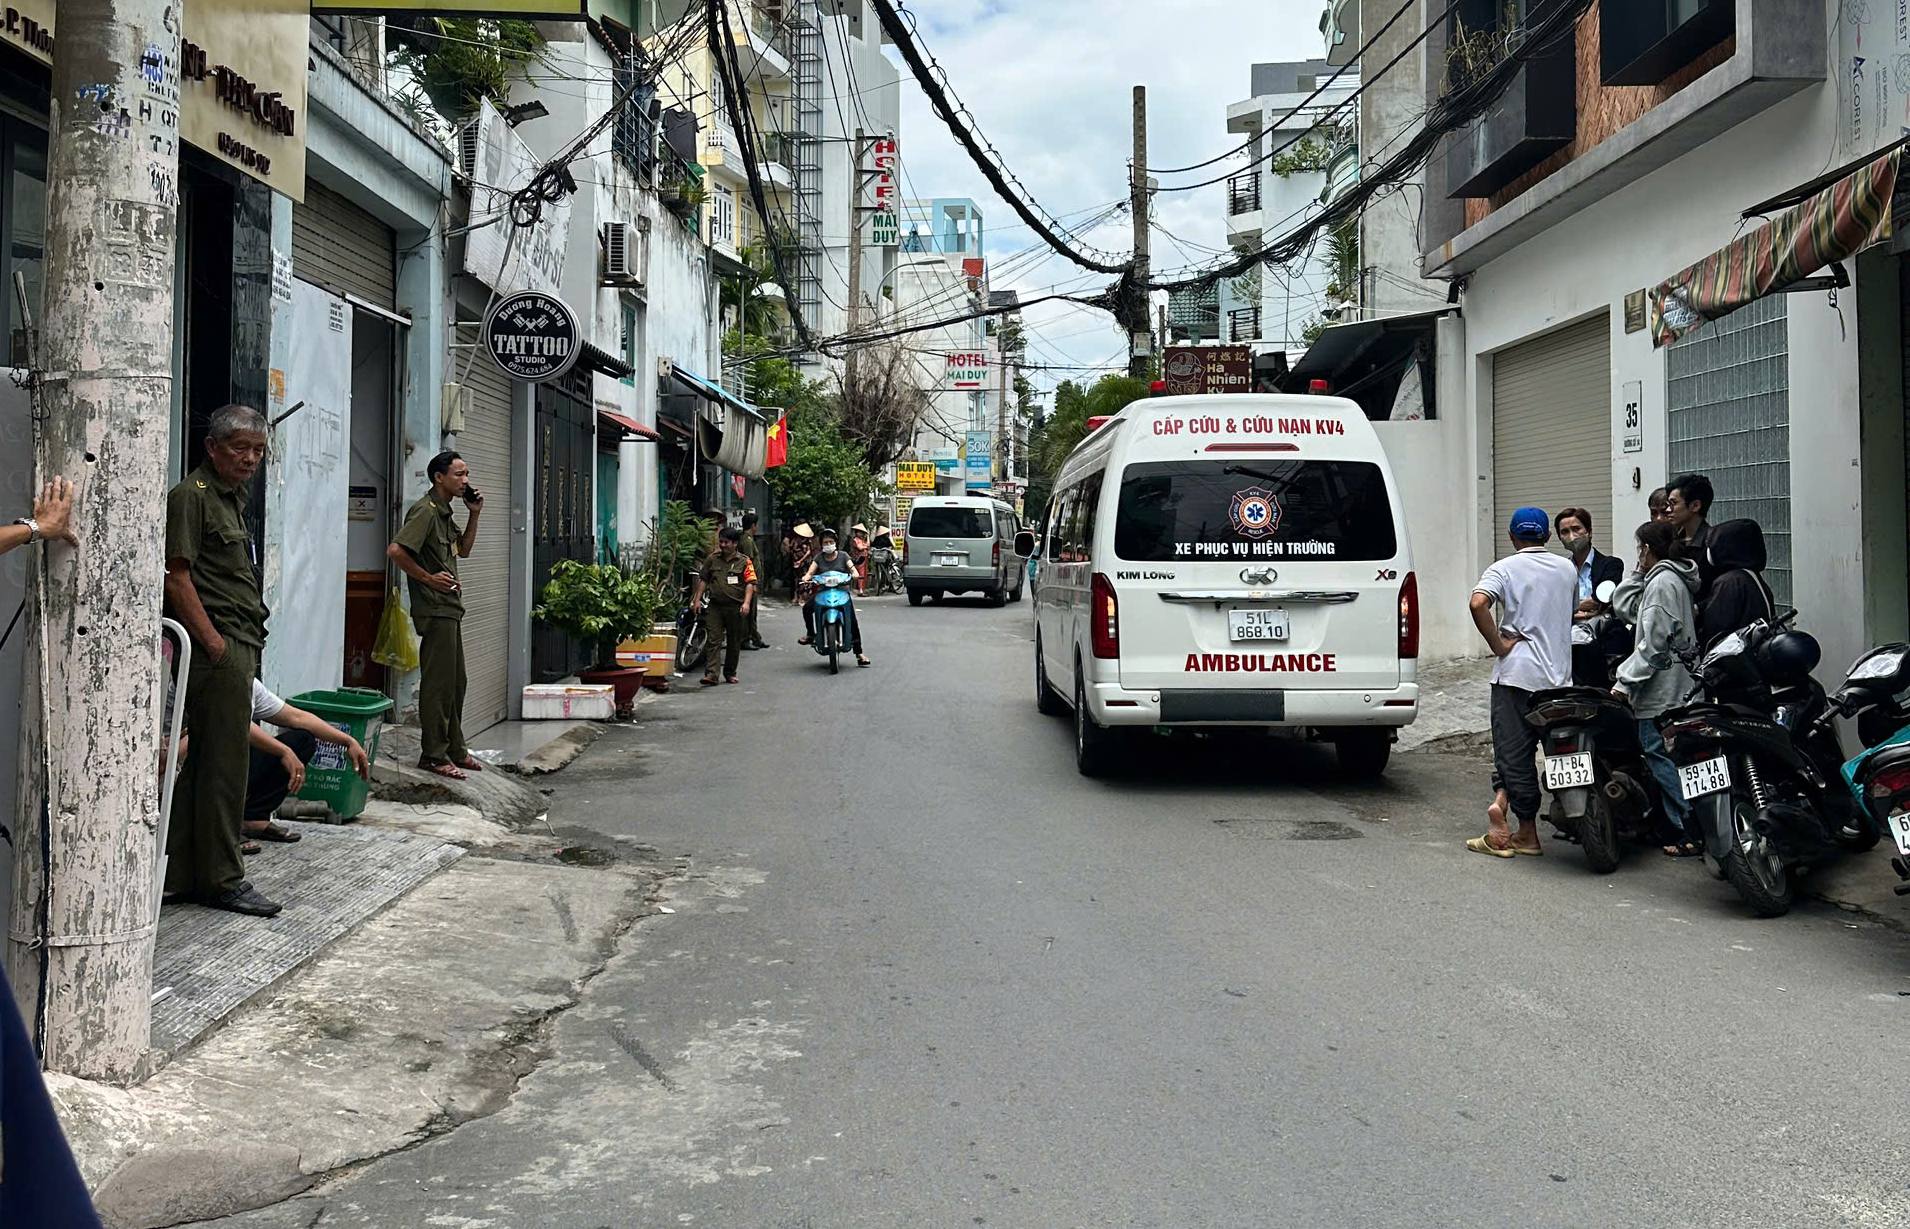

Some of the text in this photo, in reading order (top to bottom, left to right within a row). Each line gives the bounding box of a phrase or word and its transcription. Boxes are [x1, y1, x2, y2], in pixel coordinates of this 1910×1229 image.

[873, 215, 897, 228] MAI
[873, 231, 897, 243] DUY
[498, 298, 567, 327] Dương Hoàng
[494, 334, 569, 356] TATTOO
[514, 355, 546, 364] STUDIO
[947, 353, 988, 367] HOTEL
[947, 370, 988, 380] MAI DUY
[1207, 372, 1246, 385] Nhiên
[1626, 402, 1638, 429] 35
[1153, 414, 1345, 437] CẤP CỨU & CỨU NẠN KV4
[968, 440, 990, 453] 50K
[899, 464, 933, 473] MAI DUY
[1175, 539, 1336, 557] XE PHỤC VỤ HIỆN TRƯỜNG
[1116, 571, 1176, 580] KIM LONG
[1246, 612, 1272, 625] 51L
[1237, 625, 1283, 638] 868.10
[1184, 653, 1337, 672] AMBULANCE
[1551, 756, 1585, 771] 71-B4
[1685, 759, 1720, 781] 59-VA
[1550, 769, 1590, 787] 503.32
[1686, 773, 1726, 796] 114.88
